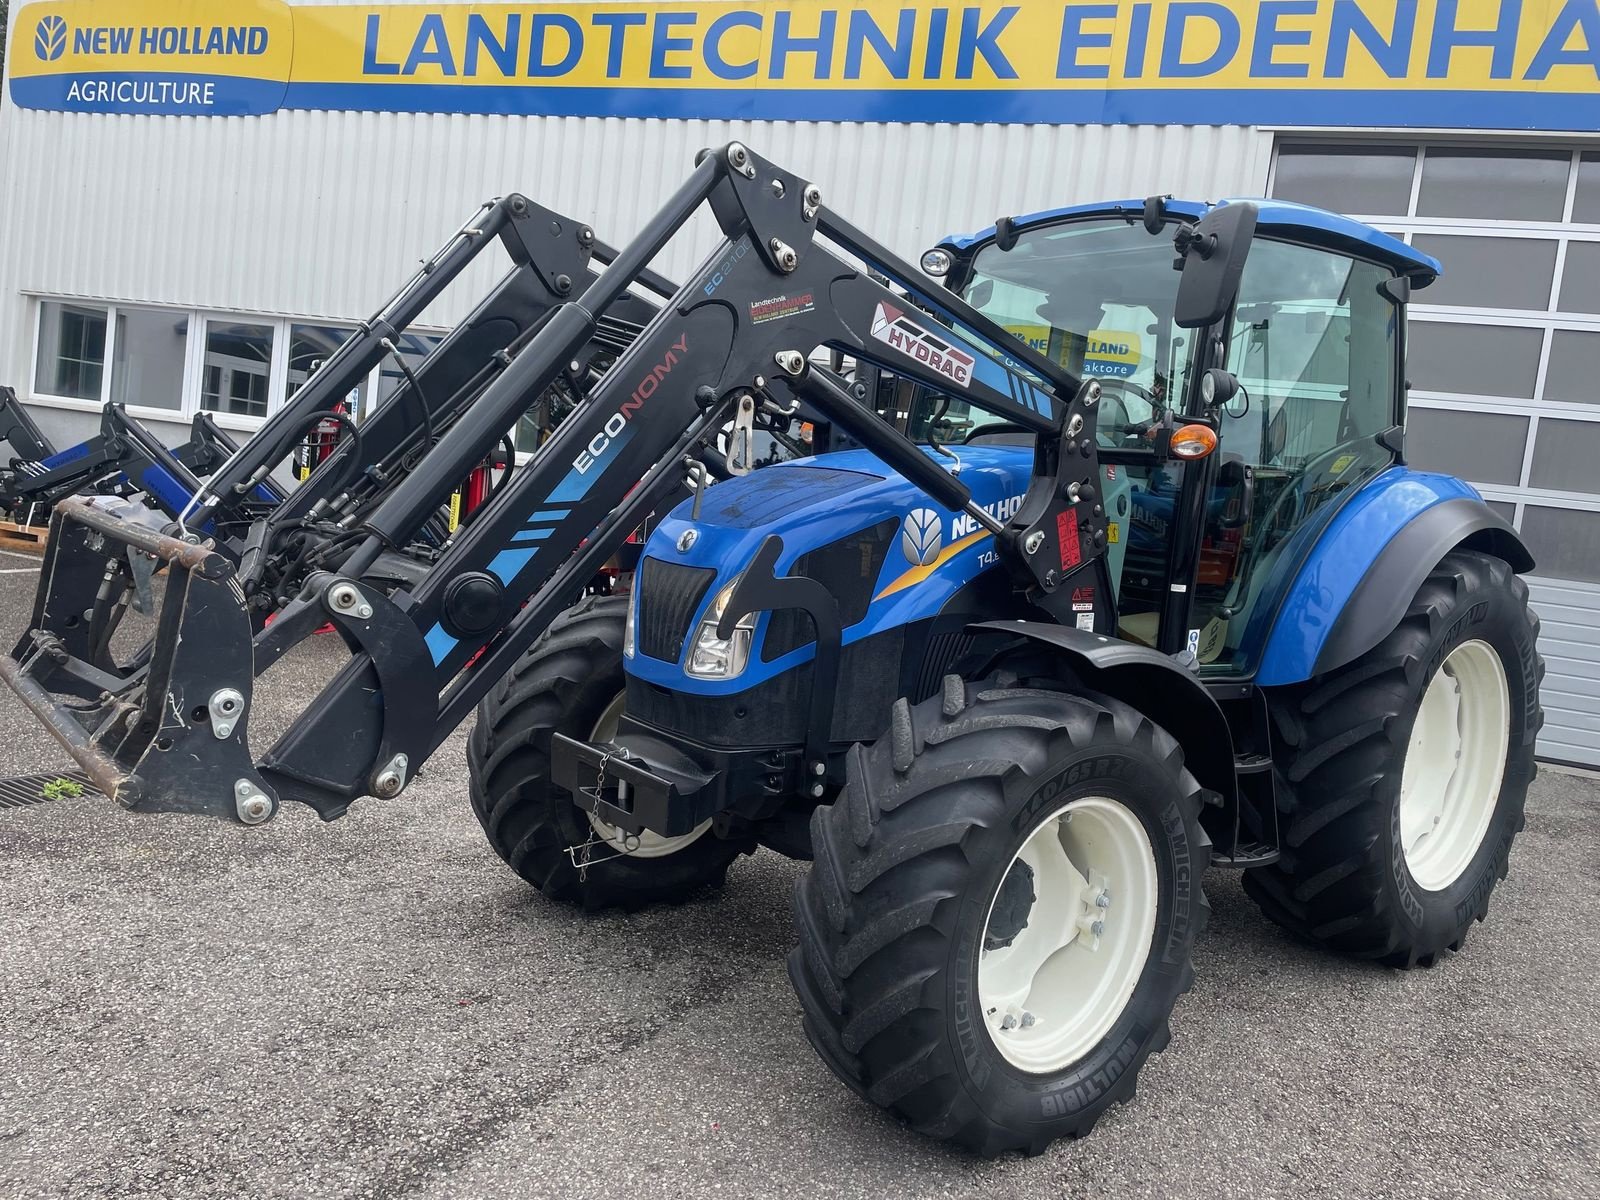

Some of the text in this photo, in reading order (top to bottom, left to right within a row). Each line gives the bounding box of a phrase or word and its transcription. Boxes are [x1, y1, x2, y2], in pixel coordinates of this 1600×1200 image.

[73, 26, 268, 55] NEW HOLLAND
[362, 6, 1021, 81] LANDTECHNIK
[67, 81, 215, 104] AGRICULTURE
[751, 295, 787, 308] Landtechnik
[888, 327, 967, 383] HYDRAC
[1029, 338, 1047, 350] NE
[1084, 363, 1128, 374] aktore
[572, 332, 688, 475] ECONOMY
[1166, 835, 1191, 963] MICHELIN
[954, 908, 978, 1060] MICHEL
[1039, 1035, 1139, 1117] MULTIBIB
